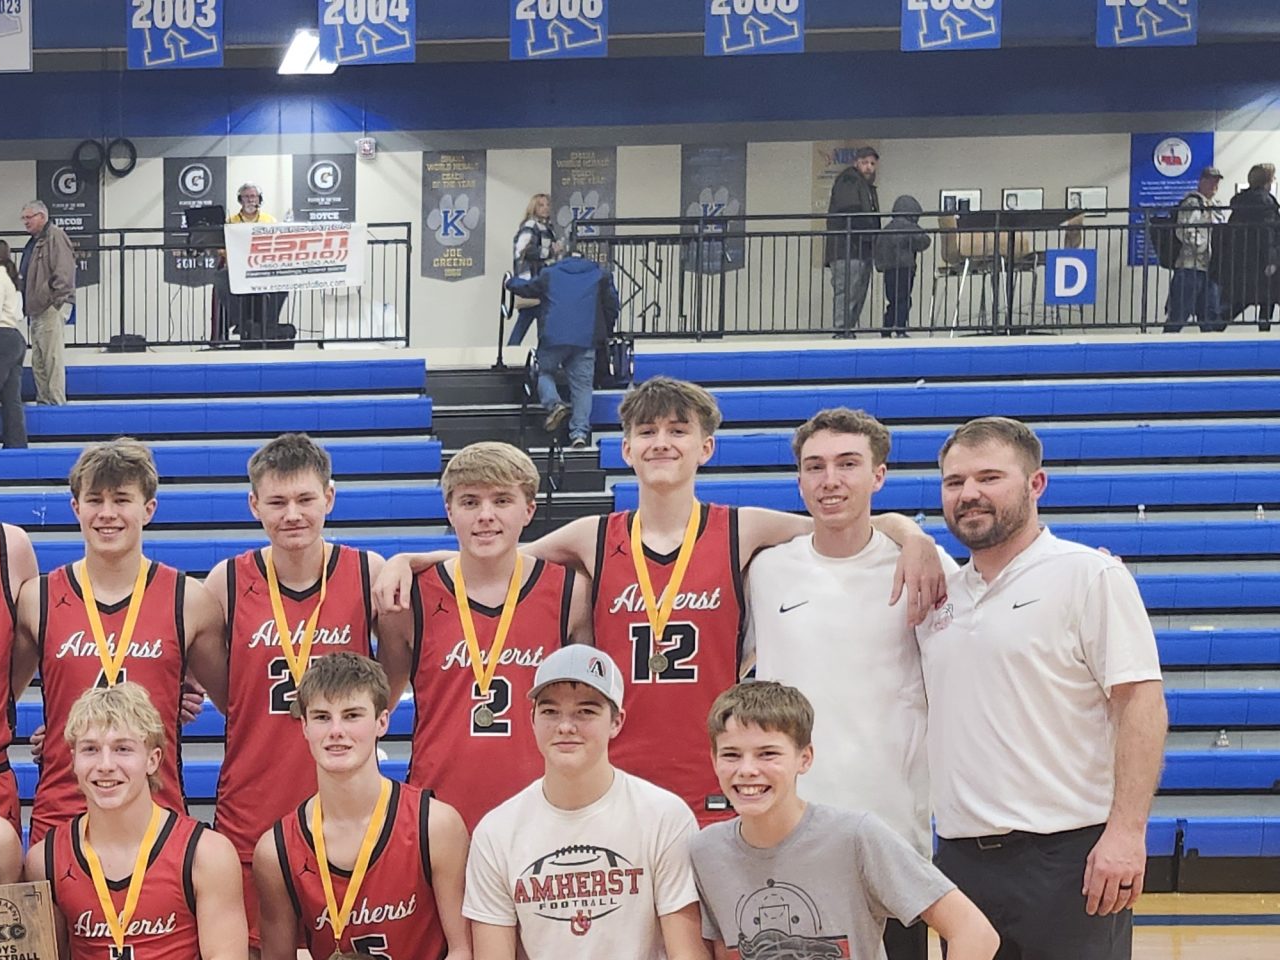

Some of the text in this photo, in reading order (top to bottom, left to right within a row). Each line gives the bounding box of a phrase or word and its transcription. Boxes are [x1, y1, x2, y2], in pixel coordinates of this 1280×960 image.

[132, 0, 217, 29] 2003
[324, 0, 409, 25] 2004
[442, 210, 466, 237] K
[250, 230, 350, 254] ESPN
[442, 248, 463, 258] JOE
[1055, 256, 1088, 298] D
[610, 583, 721, 613] Amerst
[55, 631, 163, 660] Amhrst
[629, 621, 700, 684] 12
[469, 675, 513, 737] 2
[514, 867, 644, 904] AMHERST
[539, 899, 618, 911] FOOTBALL
[74, 910, 177, 938] Amerst
